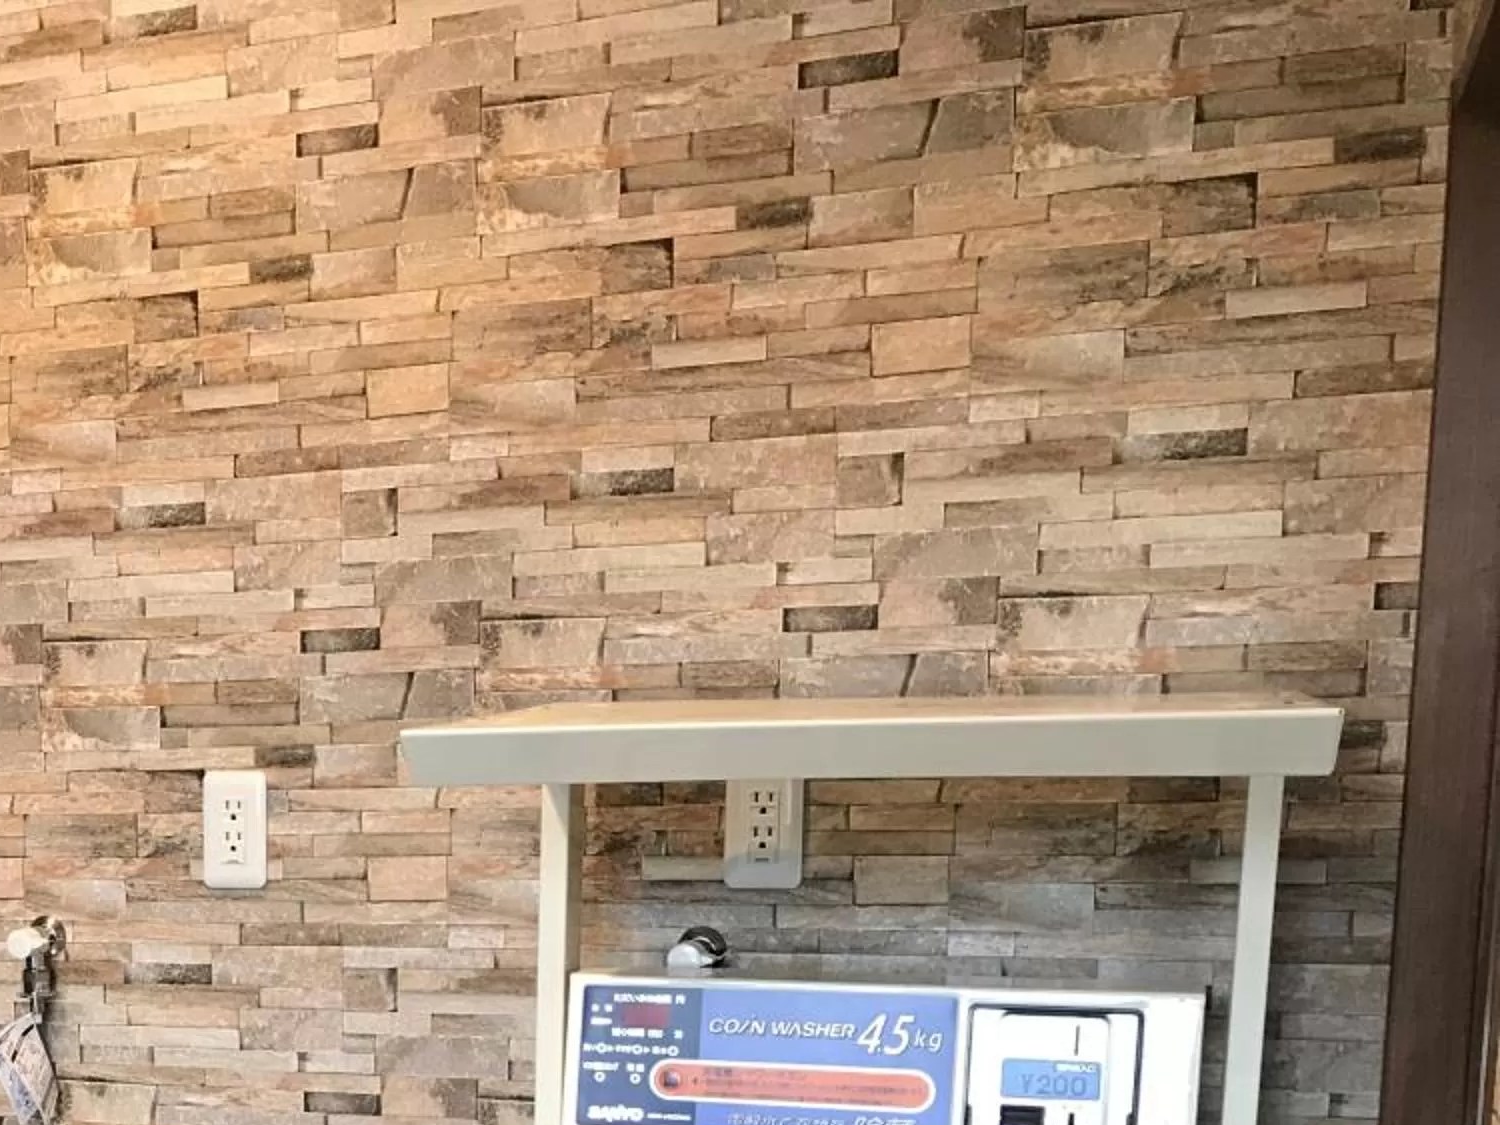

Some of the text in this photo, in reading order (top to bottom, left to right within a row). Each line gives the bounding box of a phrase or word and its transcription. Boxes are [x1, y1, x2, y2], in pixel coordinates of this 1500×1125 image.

[708, 1017, 766, 1035] COIN
[771, 1019, 857, 1039] WASHER
[913, 1028, 943, 1053] kg
